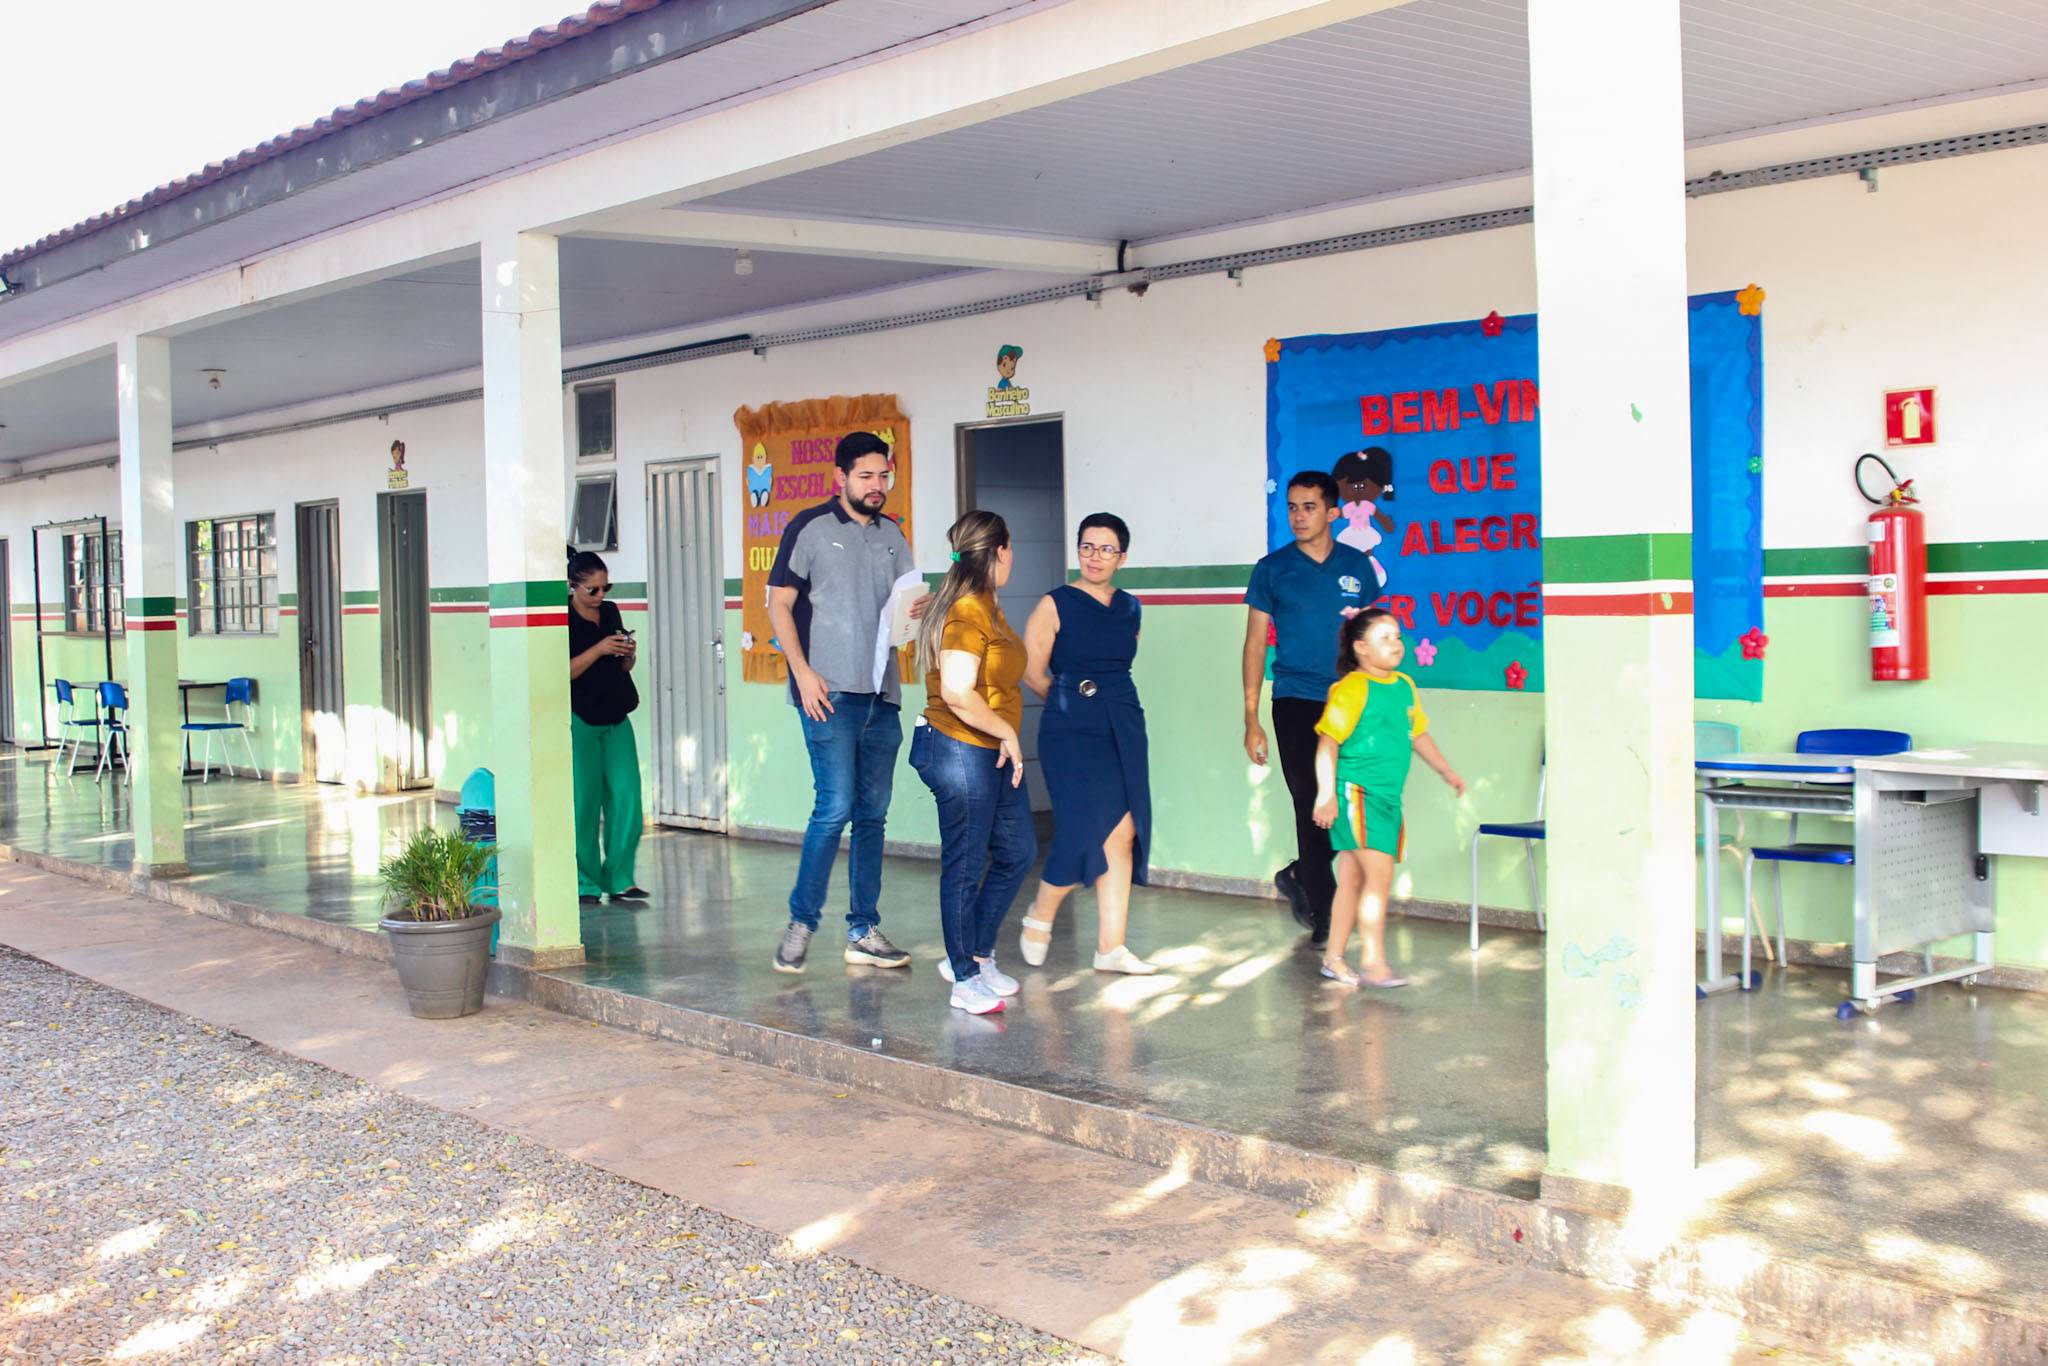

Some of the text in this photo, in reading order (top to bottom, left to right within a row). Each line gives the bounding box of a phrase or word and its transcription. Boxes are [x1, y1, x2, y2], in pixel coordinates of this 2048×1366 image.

[790, 435, 841, 466] NOSS
[1428, 453, 1517, 494] QUE
[1400, 513, 1540, 557] ALEGR
[1430, 580, 1542, 628] VOCÊ
